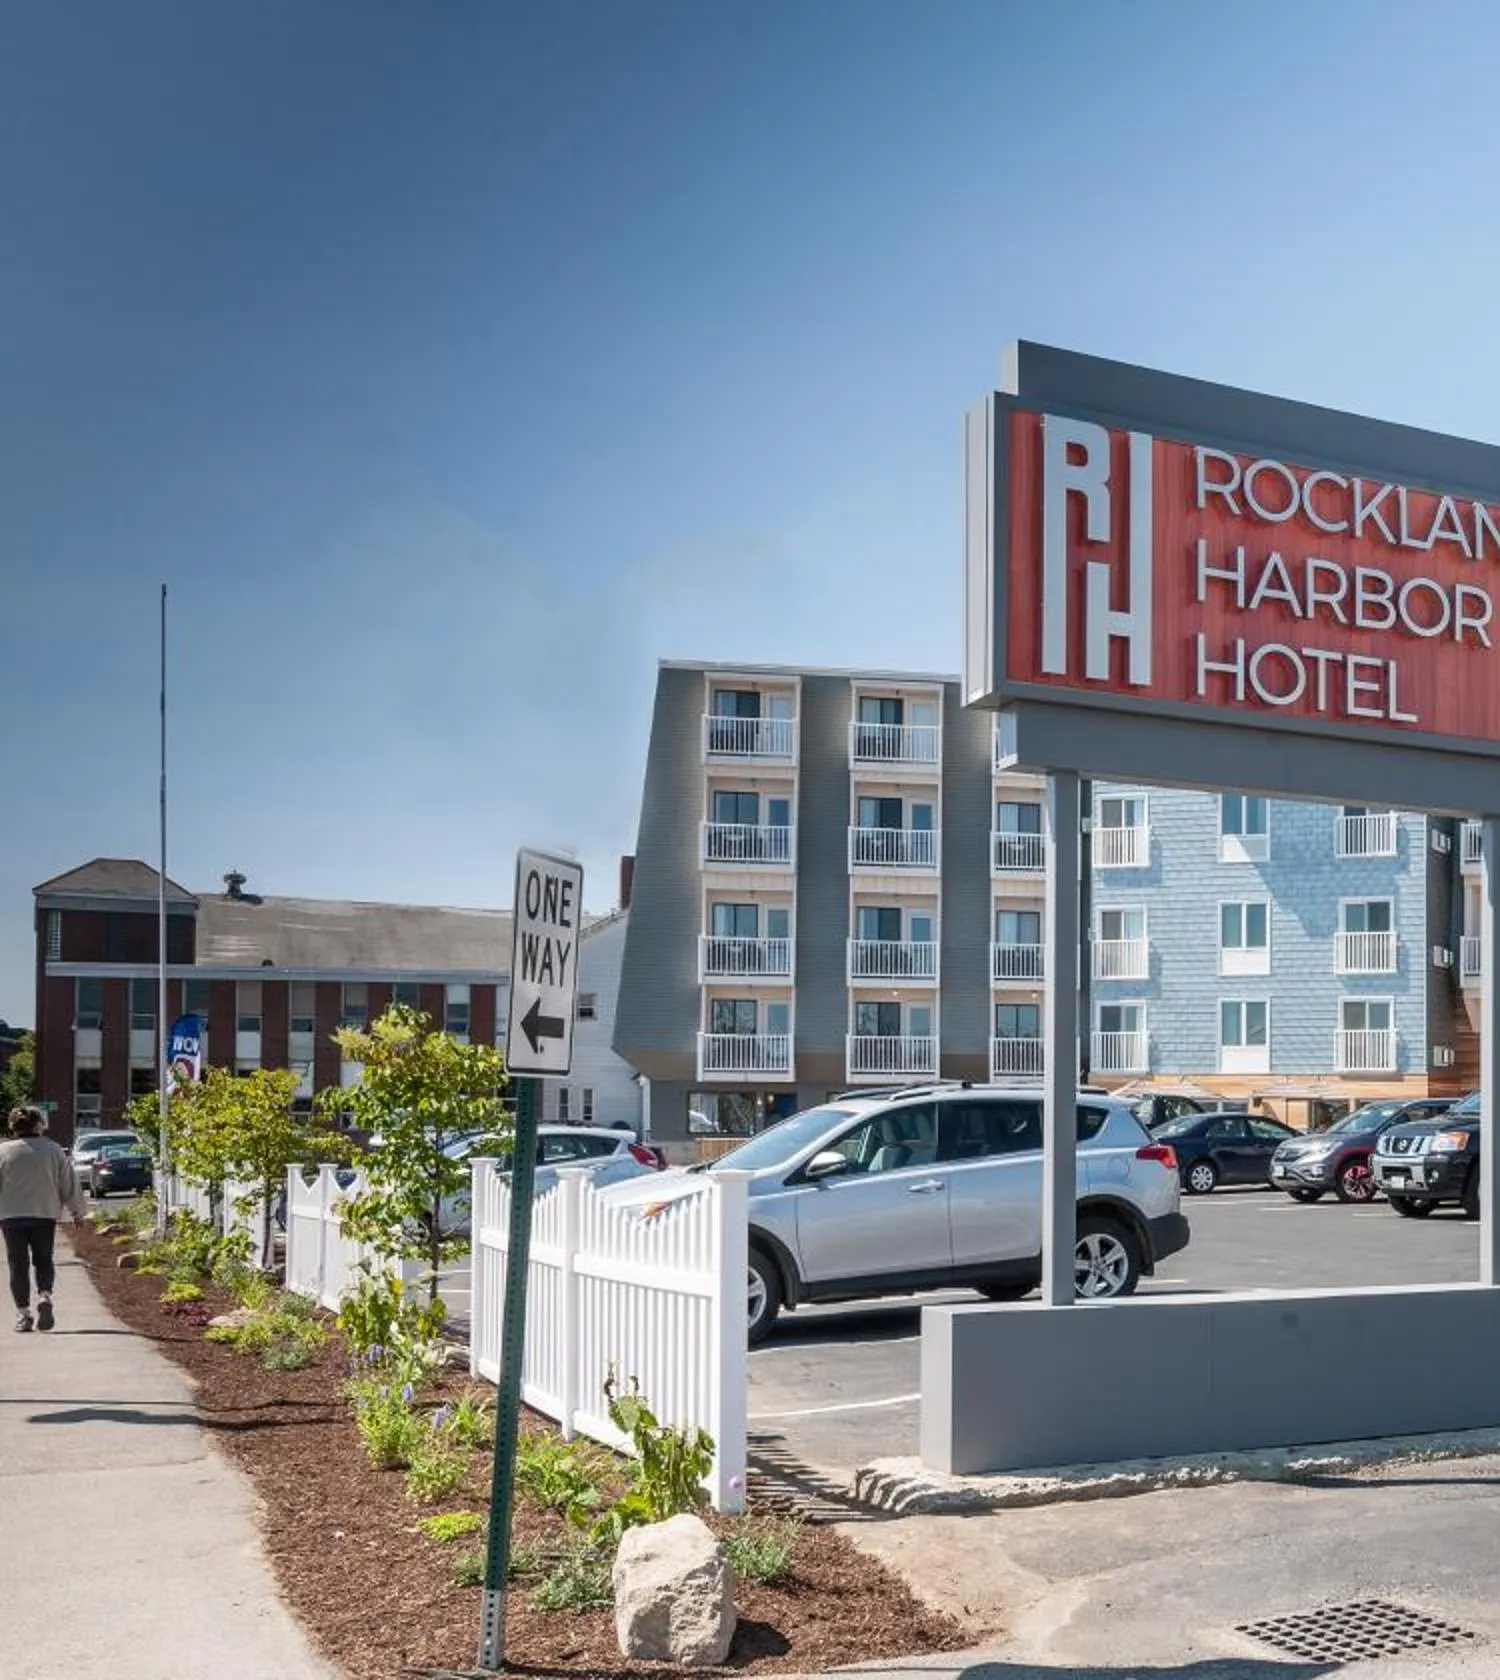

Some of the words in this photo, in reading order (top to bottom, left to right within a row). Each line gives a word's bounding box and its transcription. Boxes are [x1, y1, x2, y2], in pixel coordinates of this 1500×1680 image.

[1197, 539, 1494, 648] HARBOR
[1196, 633, 1419, 723] HOTEL
[525, 869, 573, 928] ONE
[521, 931, 570, 988] WAY
